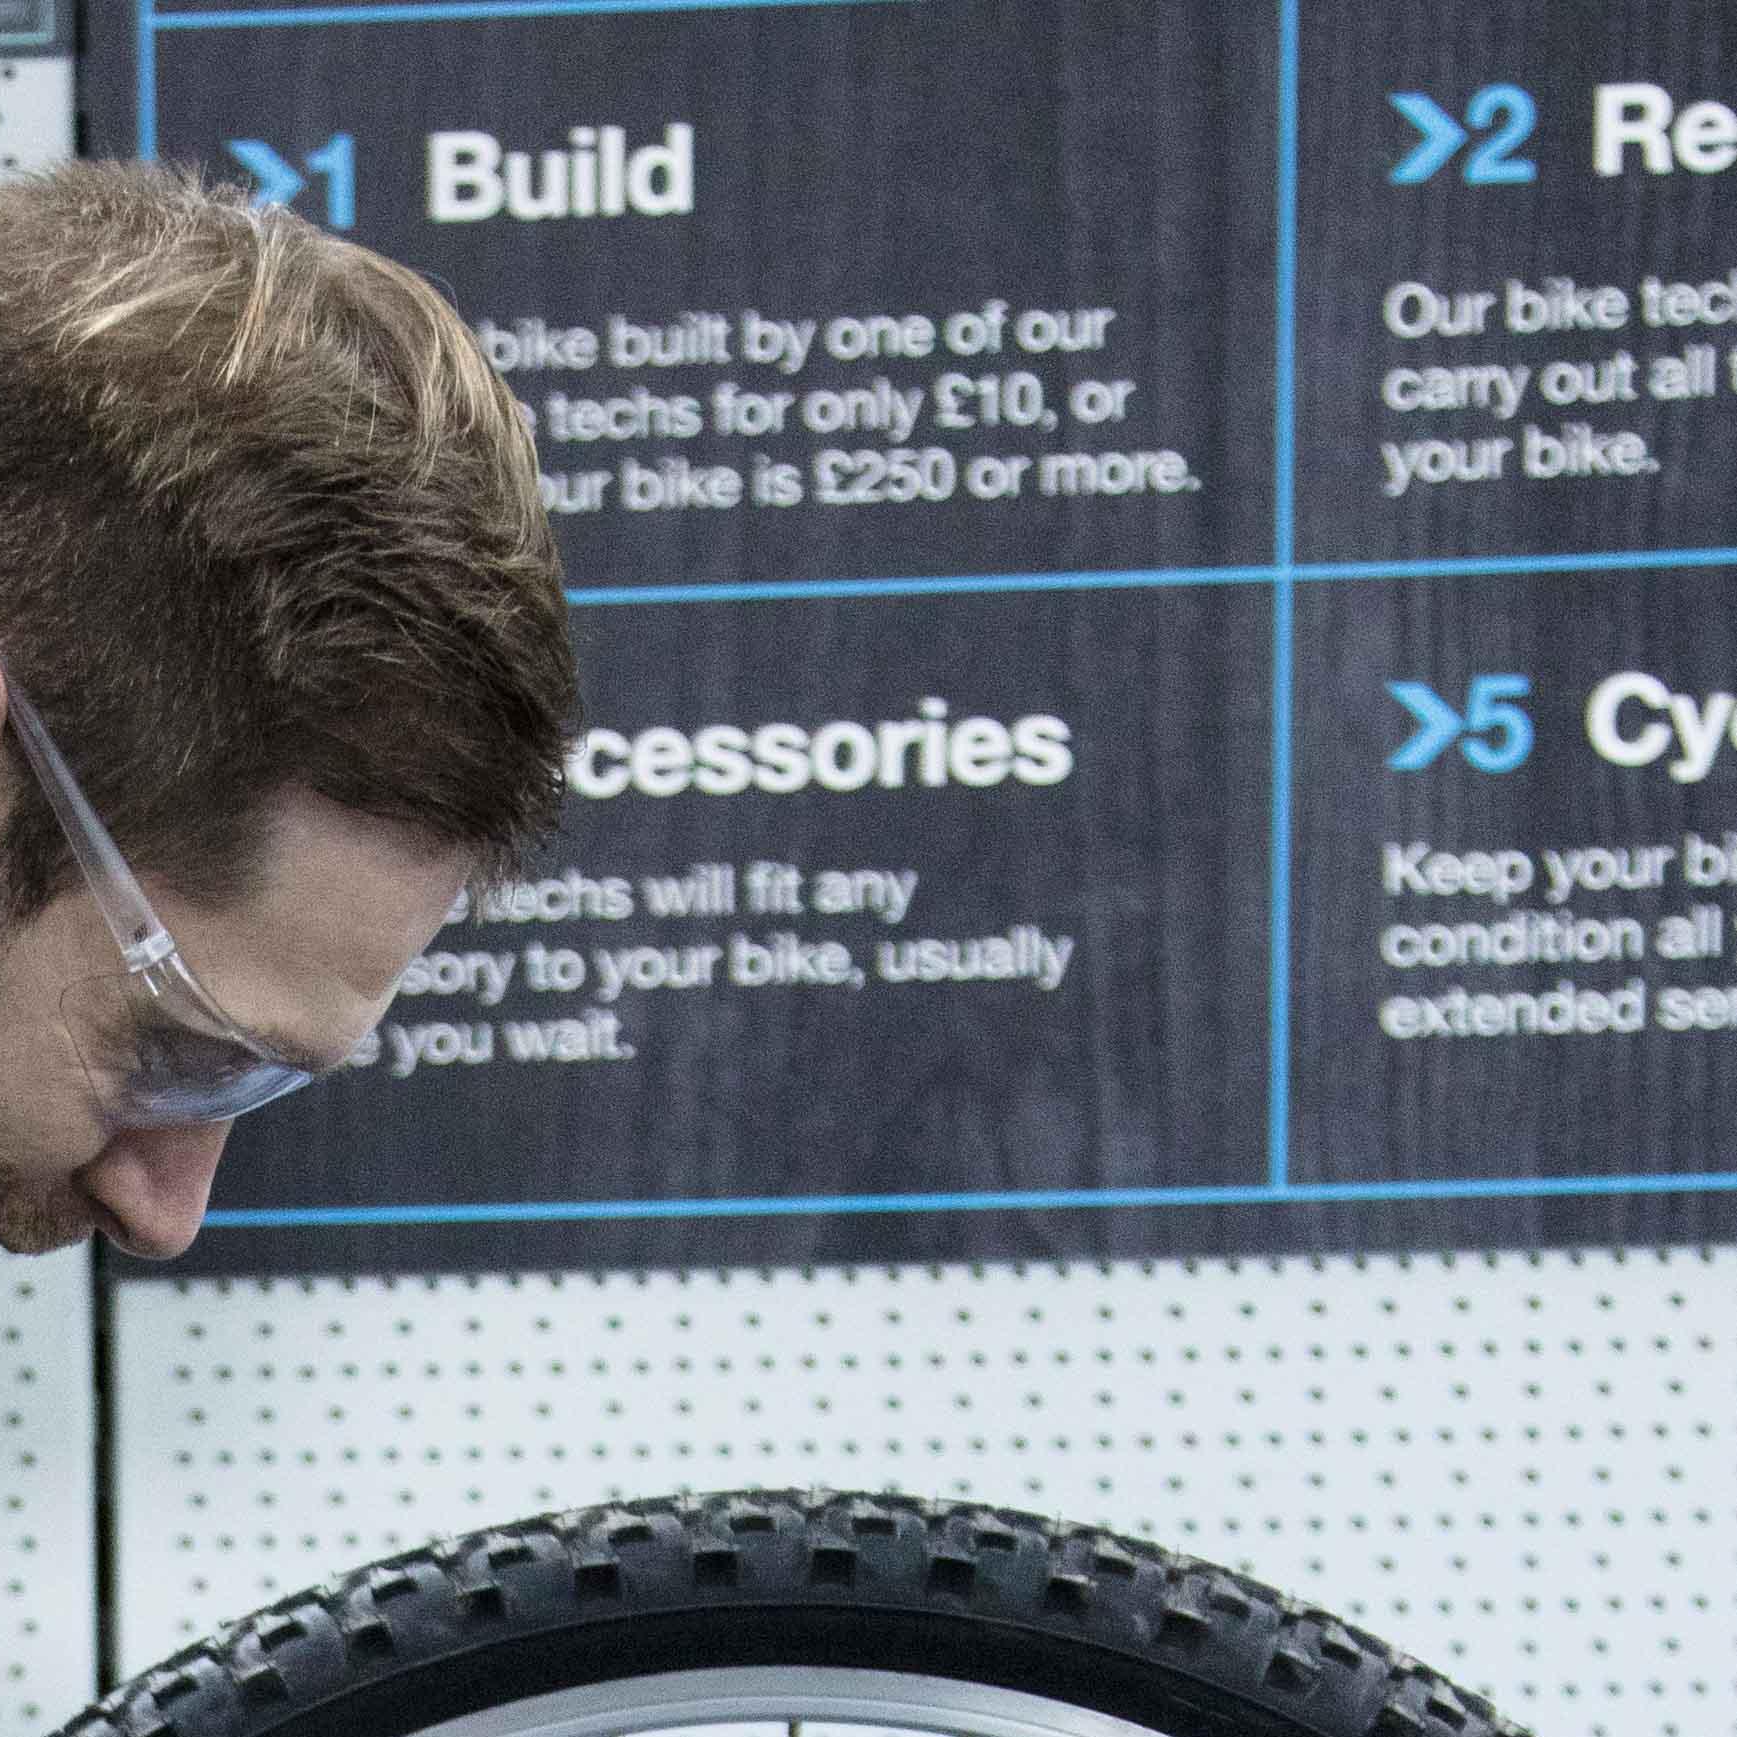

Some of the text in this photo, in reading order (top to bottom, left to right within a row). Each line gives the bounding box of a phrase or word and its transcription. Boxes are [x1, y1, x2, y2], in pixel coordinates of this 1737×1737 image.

[1593, 82, 1737, 176] Re
[426, 122, 694, 222] Build
[478, 299, 1118, 374] bike built by one of our
[1382, 281, 1498, 339] Our
[1503, 275, 1630, 334] bike
[545, 386, 703, 443] techs
[710, 381, 796, 437] for
[802, 376, 926, 444] only
[1069, 378, 1137, 424] or
[1381, 343, 1718, 420] carry out all
[618, 457, 743, 511] bike
[752, 452, 804, 508] is
[815, 446, 957, 505] £250
[966, 454, 1033, 500] or
[1038, 449, 1203, 497] more.
[1380, 422, 1662, 498] your bike.
[1584, 670, 1737, 784] Cy
[641, 861, 736, 917] will
[746, 859, 805, 914] fit
[812, 866, 919, 924] any
[1381, 840, 1535, 906] Keep
[1541, 844, 1677, 905] your
[524, 940, 587, 993] to
[594, 943, 725, 1003] your
[877, 922, 1075, 992] usually
[1379, 901, 1724, 968] condition all
[389, 1021, 495, 1079] you
[502, 1004, 638, 1064] wait.
[1379, 976, 1647, 1040] extended
